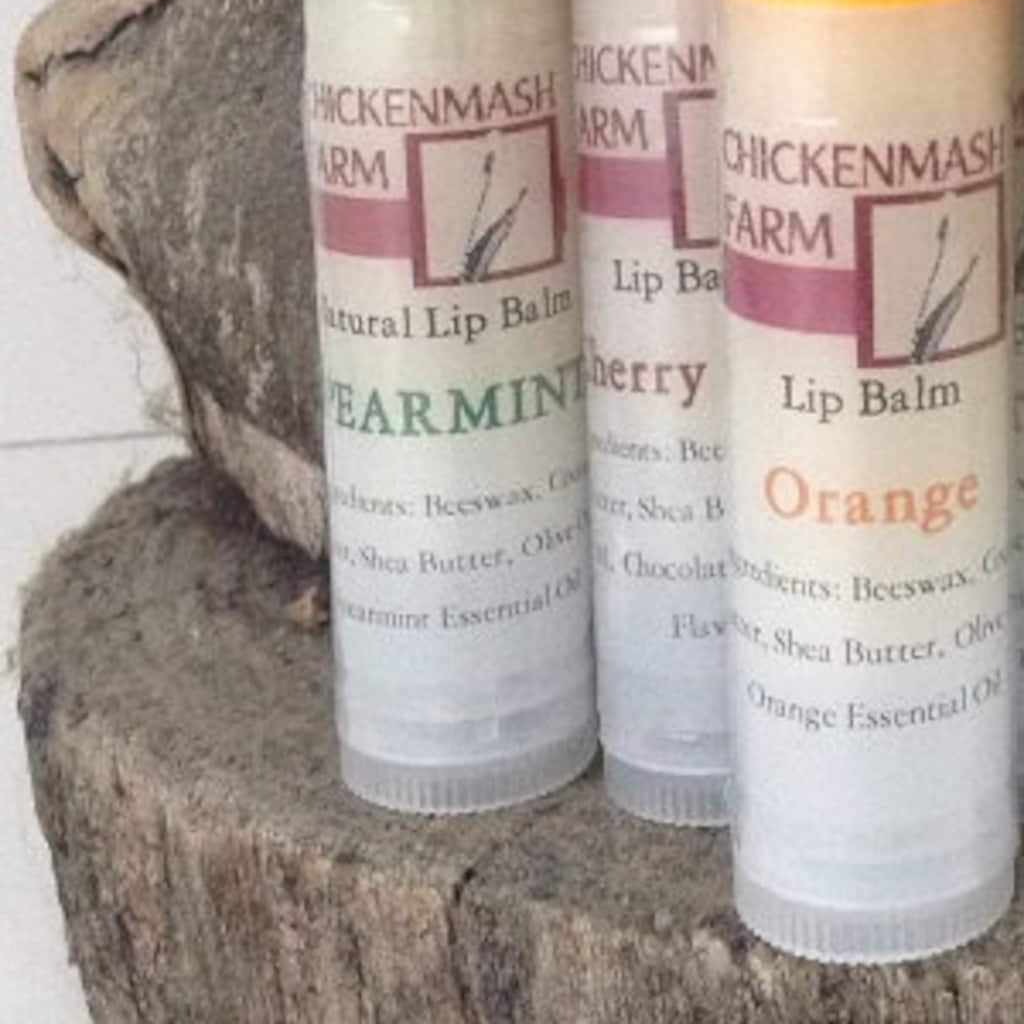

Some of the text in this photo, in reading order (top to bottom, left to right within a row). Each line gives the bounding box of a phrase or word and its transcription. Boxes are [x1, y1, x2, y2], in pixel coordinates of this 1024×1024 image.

[722, 127, 1006, 189] CHICKENMASH
[724, 194, 834, 259] FARM
[612, 259, 663, 302] Lip
[320, 287, 574, 345] atural Lip Balm
[330, 353, 588, 437] EARMINT
[782, 375, 960, 423] Lip Balm
[637, 495, 694, 522] Shea
[764, 466, 979, 534] Orange
[356, 544, 410, 575] Shea
[852, 565, 976, 602] Beeswax,
[442, 582, 551, 629] Essential
[773, 626, 830, 664] Shea
[845, 638, 945, 668] Butter,
[746, 678, 836, 732] Orange
[848, 683, 967, 732] Essential
